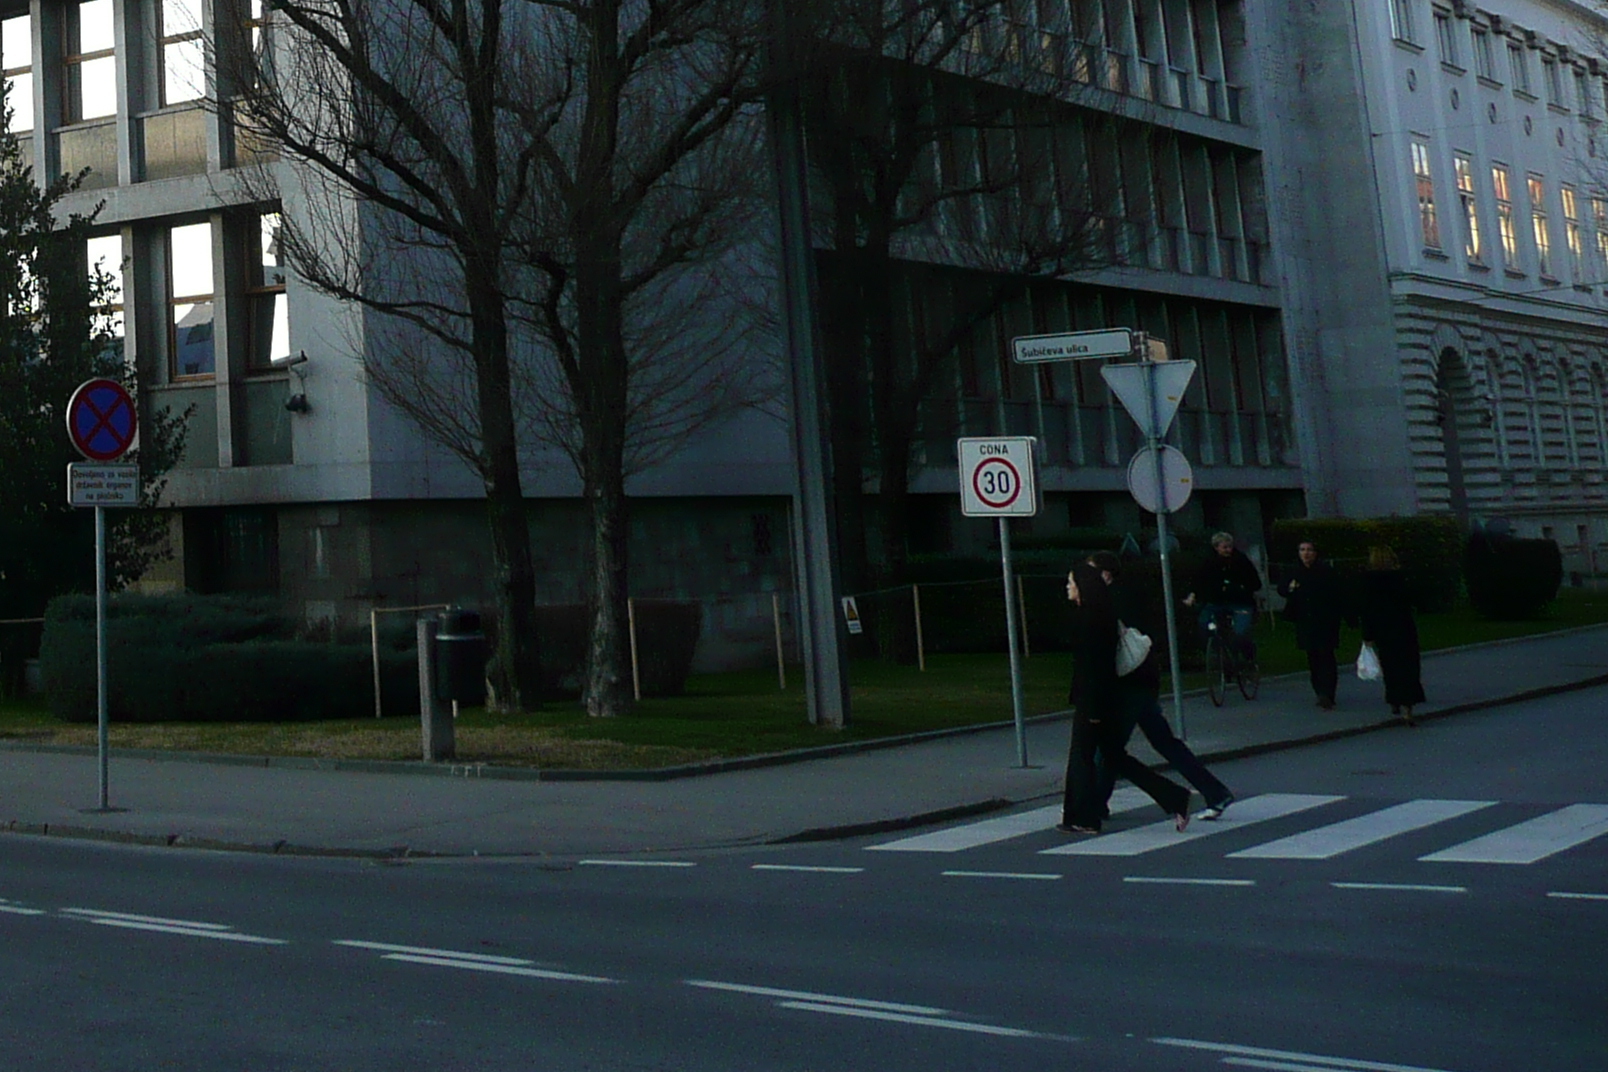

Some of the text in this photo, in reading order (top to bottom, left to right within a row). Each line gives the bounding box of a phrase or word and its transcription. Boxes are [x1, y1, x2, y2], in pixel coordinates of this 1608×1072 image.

[1021, 344, 1089, 358] Šubičeva ulica
[979, 443, 1009, 455] CONA
[983, 471, 1010, 494] 30
